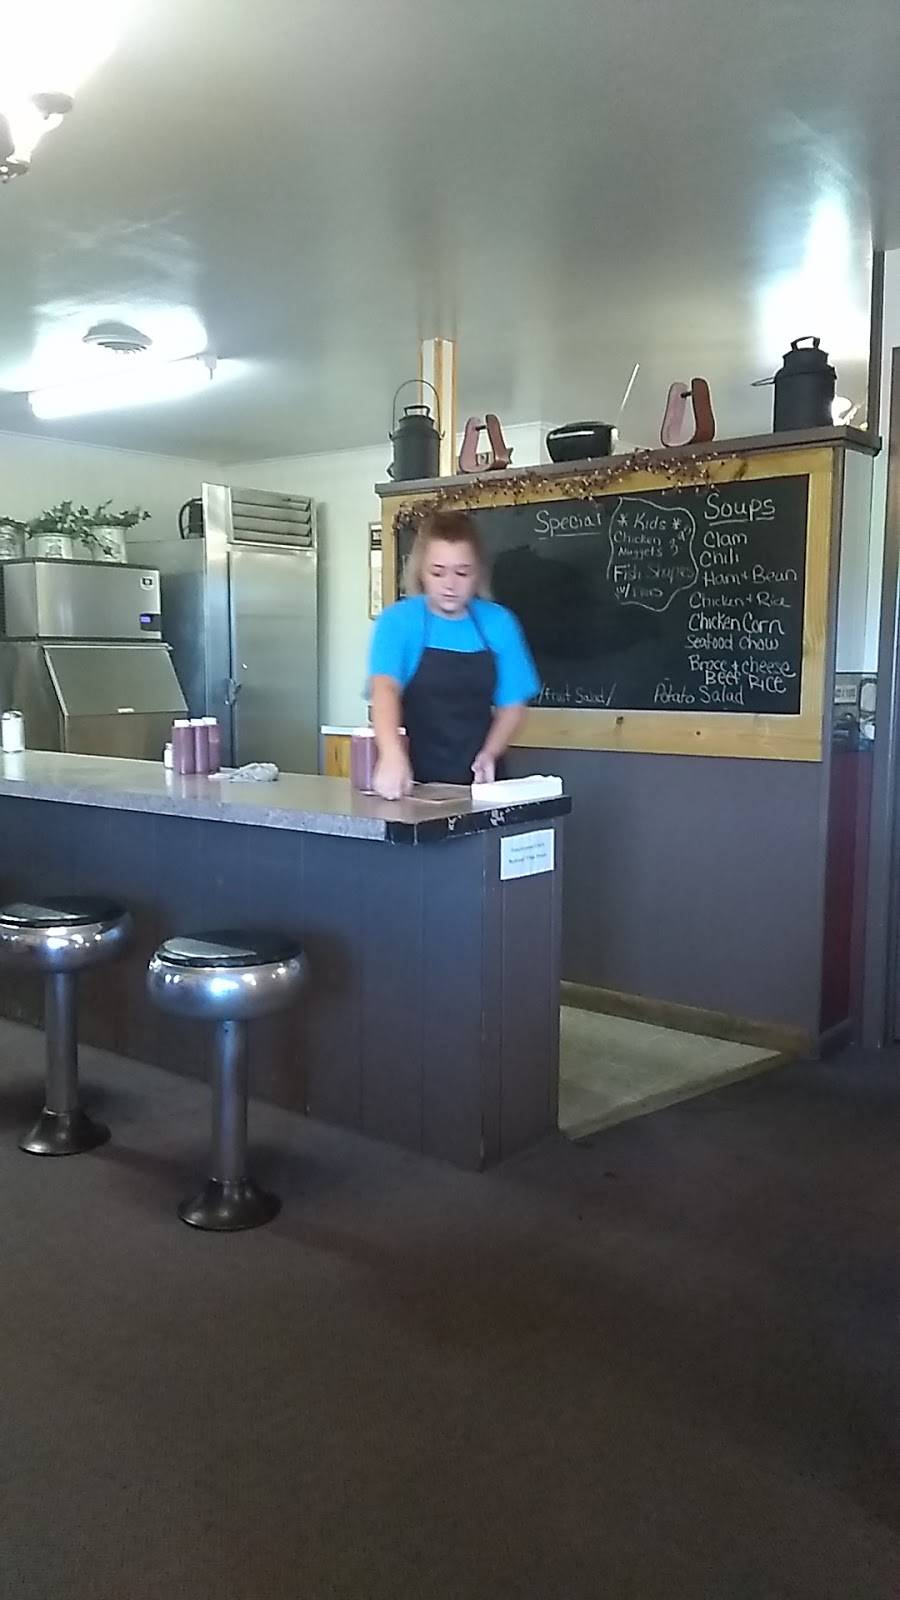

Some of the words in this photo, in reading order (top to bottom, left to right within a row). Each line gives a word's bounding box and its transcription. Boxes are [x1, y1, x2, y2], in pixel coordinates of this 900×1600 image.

[704, 492, 776, 522] Soups
[533, 510, 602, 537] Special
[633, 512, 667, 531] Kids
[703, 530, 748, 548] Clam
[700, 547, 739, 568] Chili
[703, 570, 741, 588] Ham
[752, 564, 798, 584] Bean
[689, 591, 745, 609] Chicken
[756, 591, 791, 607] Rice
[688, 611, 741, 632] Chicken
[742, 611, 785, 635] Corn
[685, 633, 734, 651] Seafood
[705, 669, 742, 686] Beef
[654, 682, 696, 704] Potato
[699, 684, 744, 706] Salad
